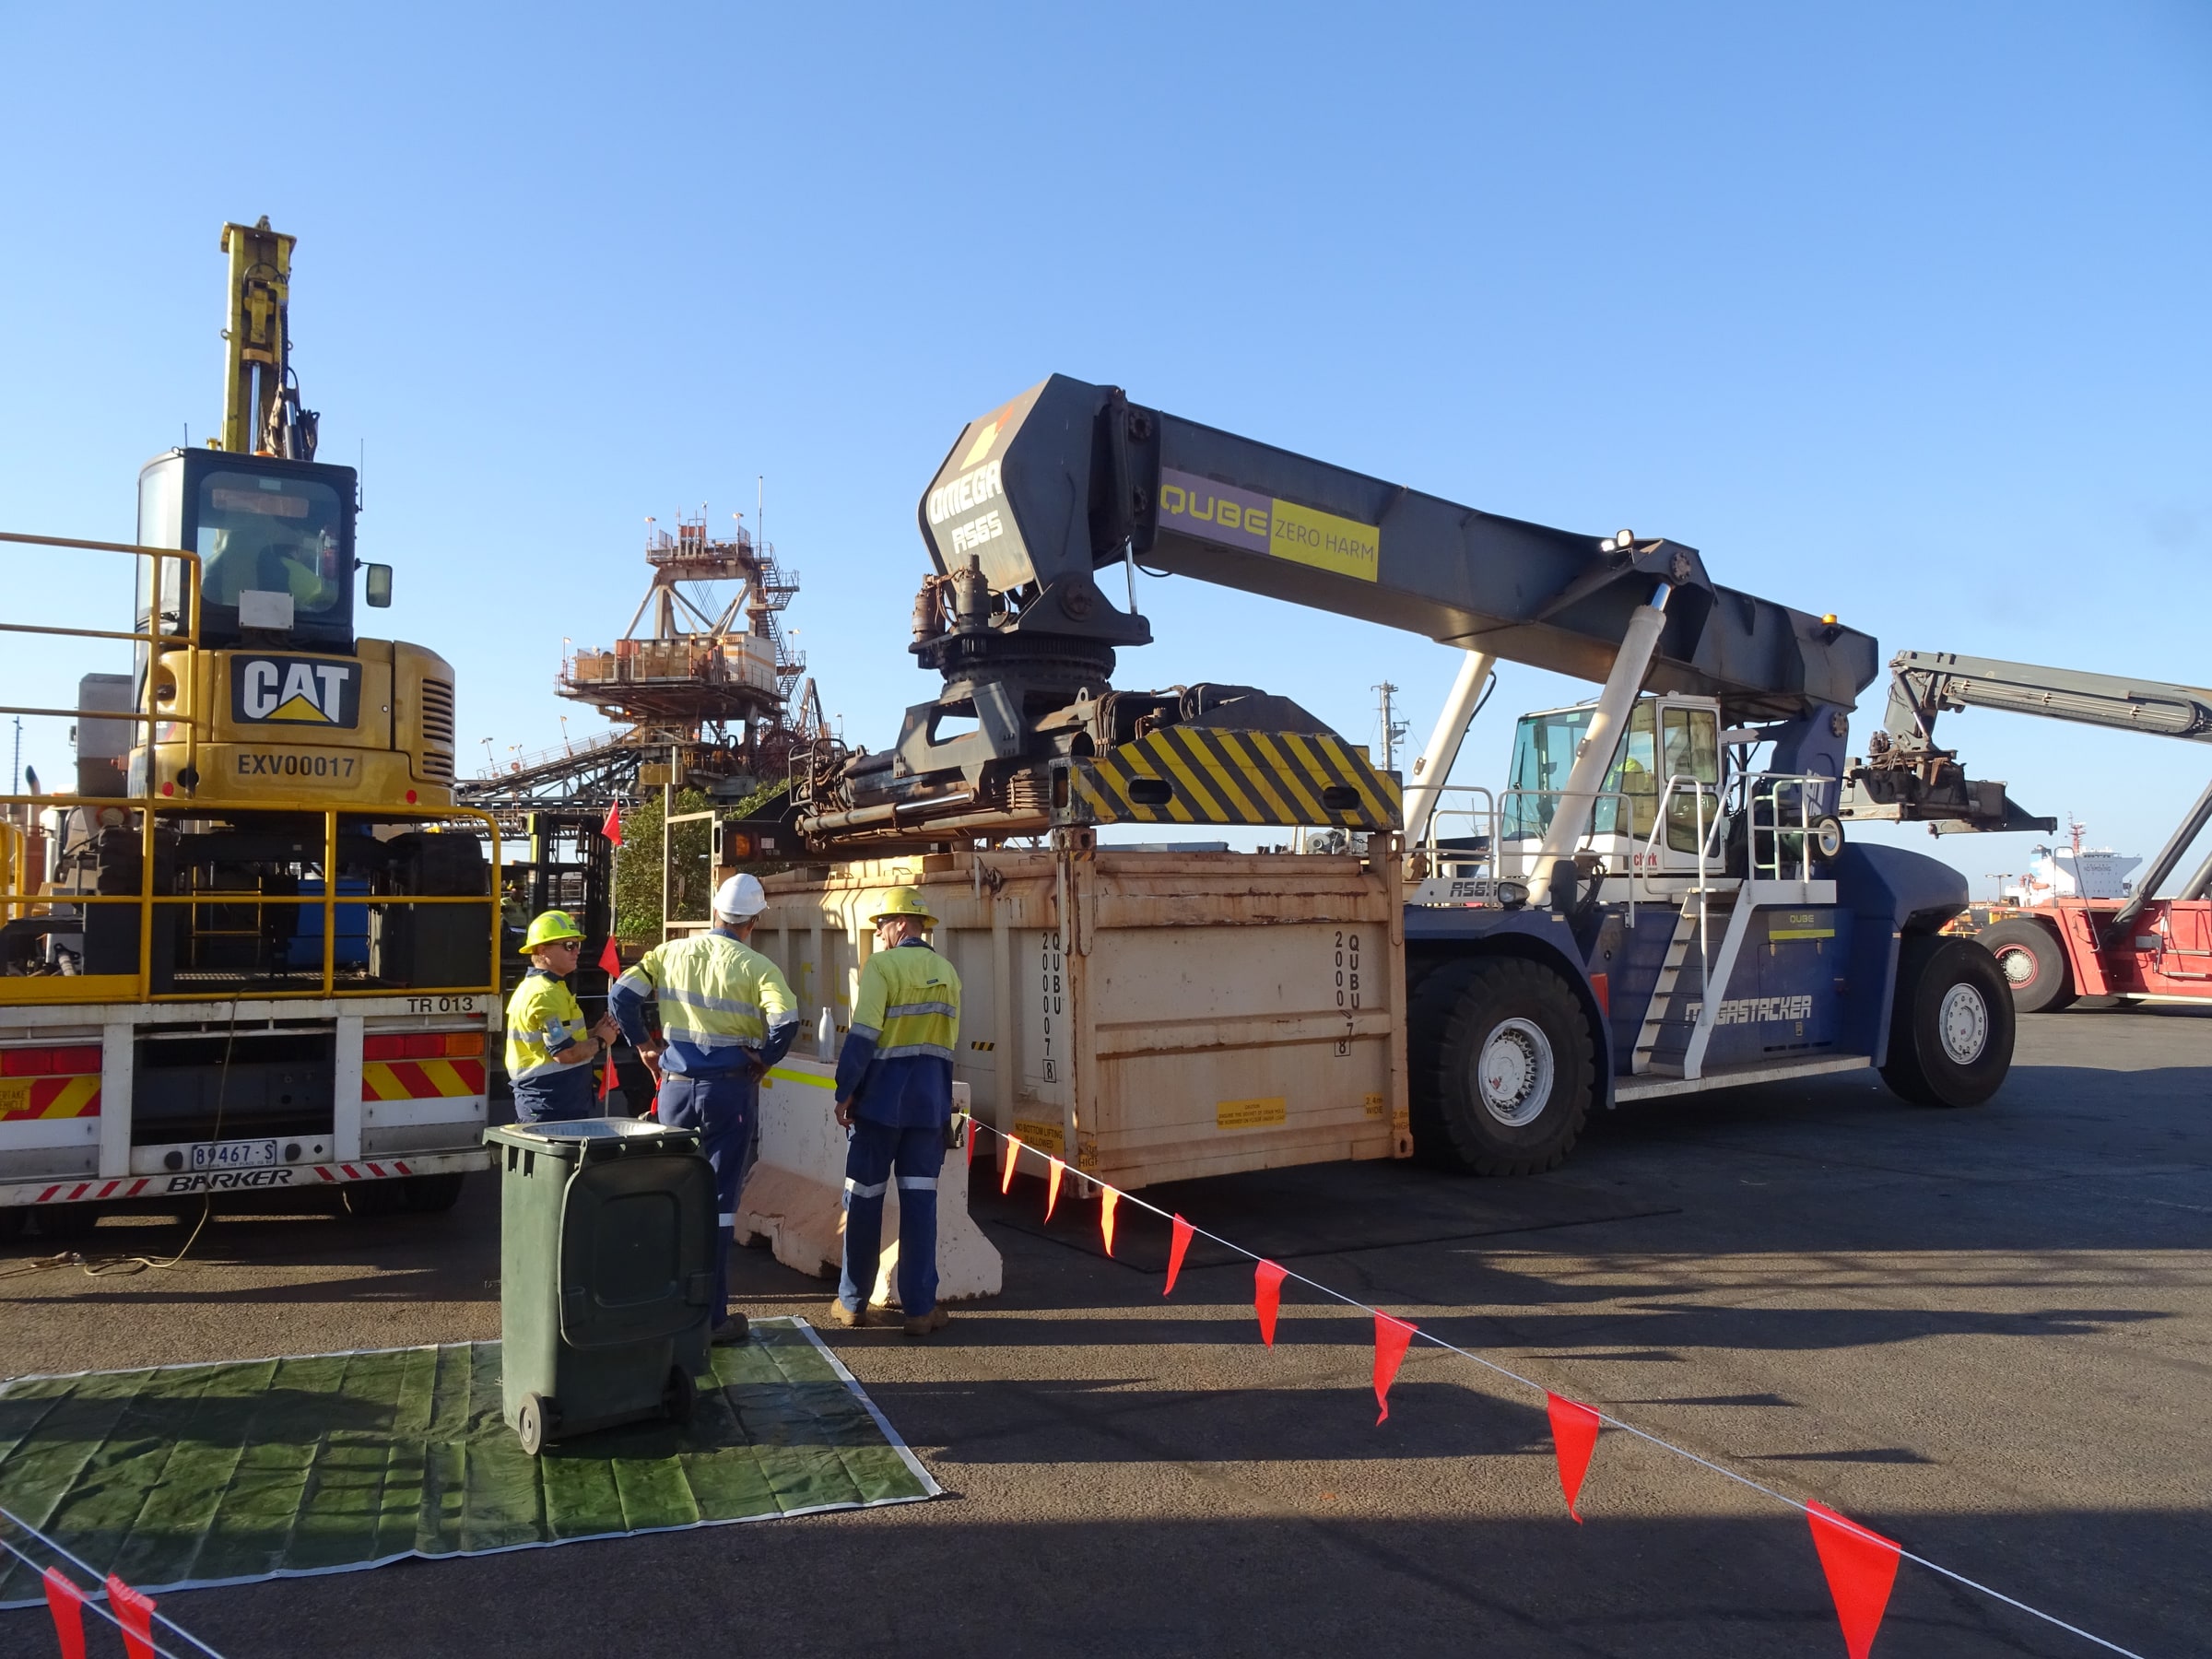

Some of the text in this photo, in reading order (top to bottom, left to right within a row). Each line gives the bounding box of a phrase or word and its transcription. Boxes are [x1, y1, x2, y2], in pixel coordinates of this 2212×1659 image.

[930, 460, 1002, 525] OMEGA
[1159, 484, 1374, 562] QUBE ZERO HARM
[243, 660, 349, 724] CAT
[238, 754, 355, 777] EXV00017
[1633, 853, 1658, 866] clrk
[1789, 914, 1815, 924] QUBE
[1348, 935, 1359, 1010] QUBU
[406, 996, 473, 1012] TR 013
[1684, 994, 1813, 1026] MGASTACKER
[1366, 1106, 1383, 1114] WIDE
[1015, 1123, 1063, 1140] NO BOTTOM LIFTING
[1030, 1136, 1053, 1149] ALLOWED
[167, 1169, 293, 1192] BARKER
